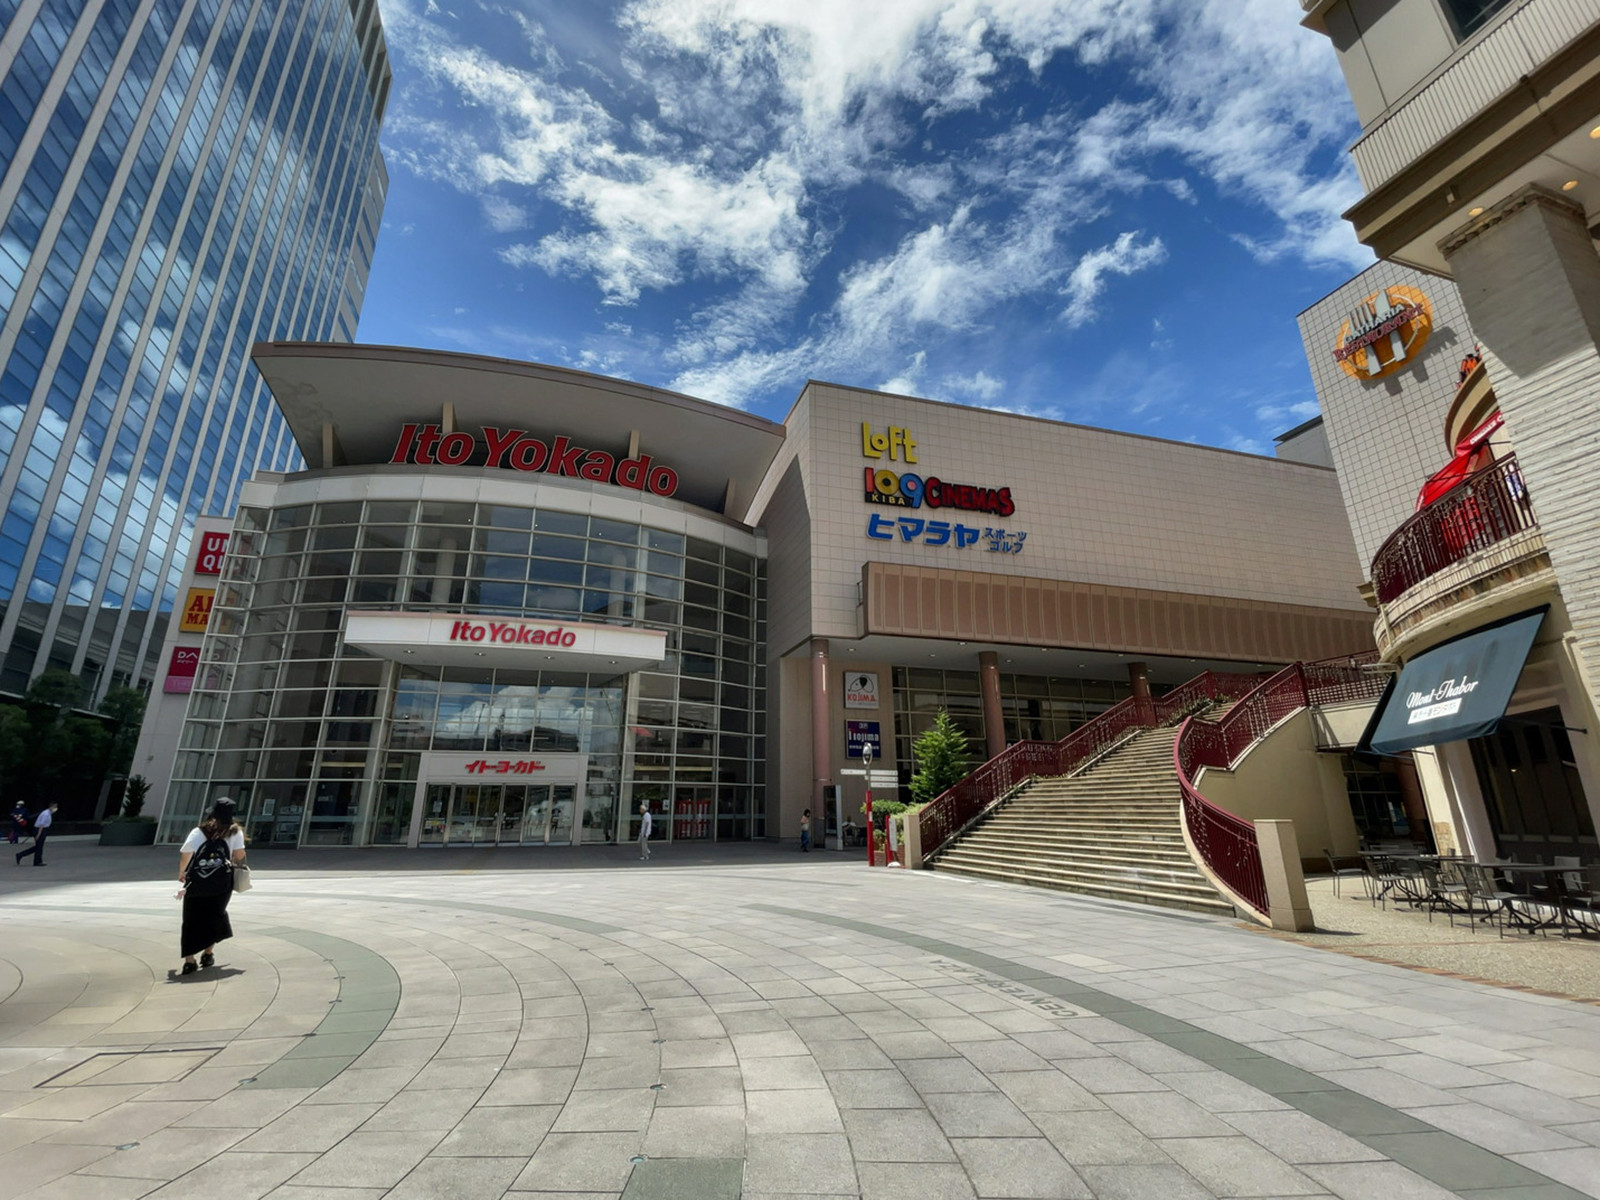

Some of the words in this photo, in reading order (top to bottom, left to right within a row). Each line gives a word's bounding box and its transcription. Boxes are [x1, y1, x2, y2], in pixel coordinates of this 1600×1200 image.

[864, 466, 924, 509] 109
[924, 476, 1016, 518] CINEMAS
[872, 494, 905, 506] KIBA
[866, 513, 981, 549] ヒマラヤ
[983, 527, 1028, 542] スポーツ
[988, 540, 1025, 555] ゴルフ
[465, 760, 546, 774] イトーヨーカドー
